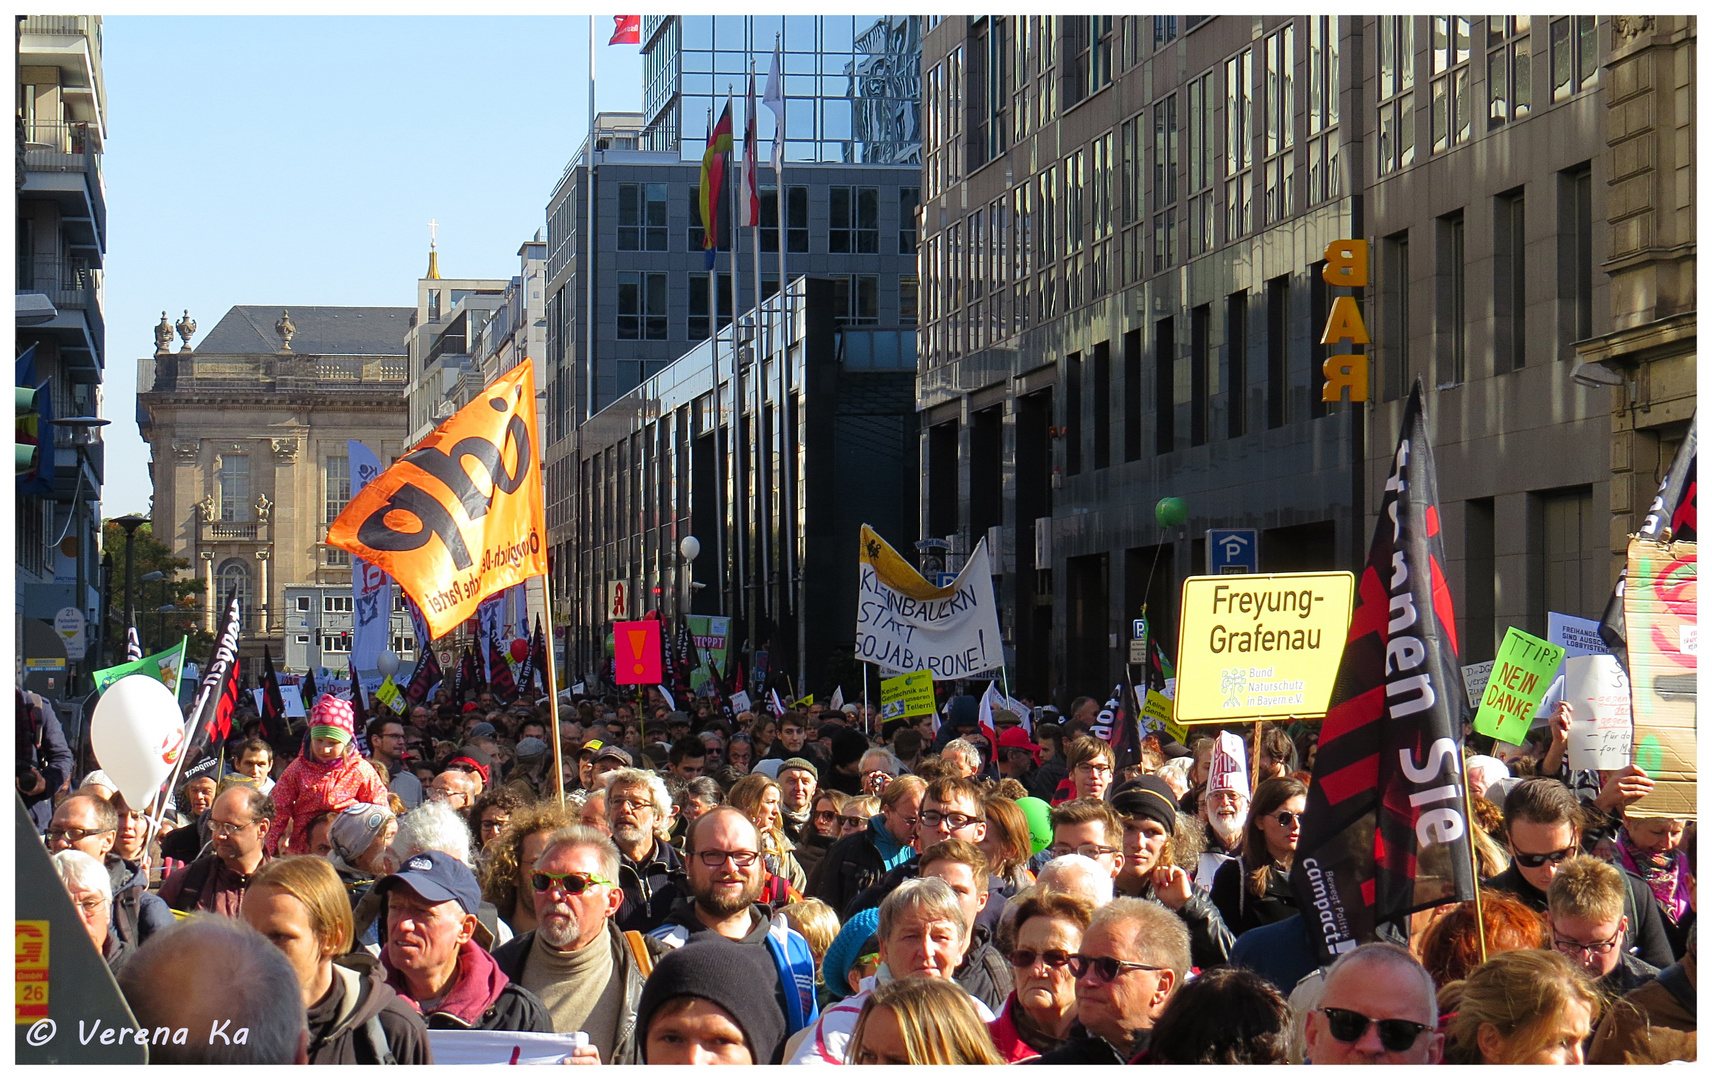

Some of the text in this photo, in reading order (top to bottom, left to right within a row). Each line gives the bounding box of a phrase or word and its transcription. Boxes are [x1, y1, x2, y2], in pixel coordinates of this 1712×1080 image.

[1226, 543, 1240, 562] P
[1213, 585, 1325, 621] Freyung-
[65, 609, 74, 617] 21
[1209, 623, 1322, 654] Grafenau
[1562, 632, 1578, 641] SIND
[854, 629, 988, 676] SOJABARONE!
[1509, 632, 1559, 667] TTIP?
[1248, 667, 1273, 678] Bund
[1498, 662, 1540, 695] NEIN
[881, 686, 899, 695] Keine
[1248, 679, 1304, 693] Naturschutz
[881, 688, 917, 703] Gentechnik
[905, 694, 931, 703] unseren
[1246, 695, 1255, 706] in
[1257, 694, 1287, 708] Bayern
[905, 701, 934, 711] Tellern!
[1146, 698, 1166, 712] Keine
[1486, 685, 1534, 721] DANKE
[1600, 717, 1628, 726] gegen
[1602, 730, 1619, 743] für
[1399, 737, 1464, 848] Sie
[1325, 869, 1350, 939] Bewegt Politik
[17, 971, 43, 980] GmbH
[23, 985, 44, 1001] 26
